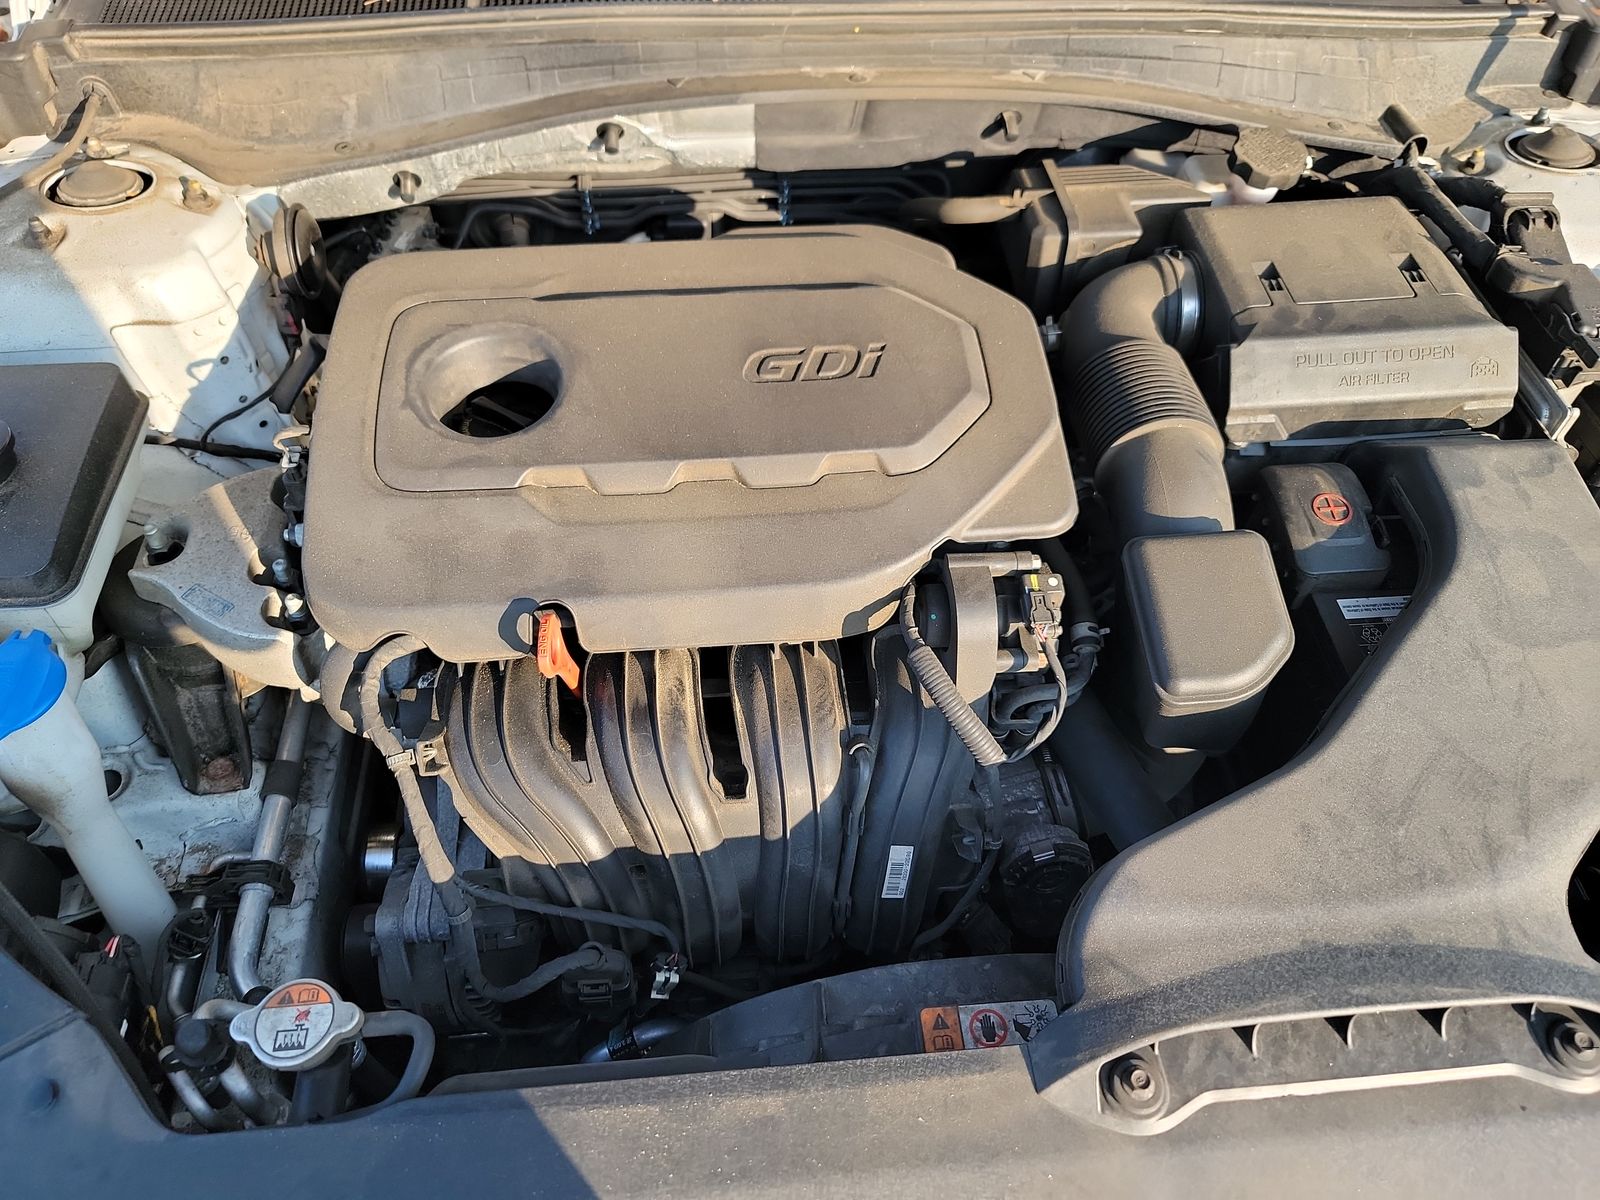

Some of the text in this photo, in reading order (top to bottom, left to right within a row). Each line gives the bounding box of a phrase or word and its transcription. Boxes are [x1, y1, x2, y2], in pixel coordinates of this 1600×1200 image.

[742, 342, 887, 383] GDi
[1295, 344, 1456, 368] PULL OUT TO OPEN
[1338, 371, 1410, 387] AIR FILTER
[538, 618, 551, 656] ENG OIL
